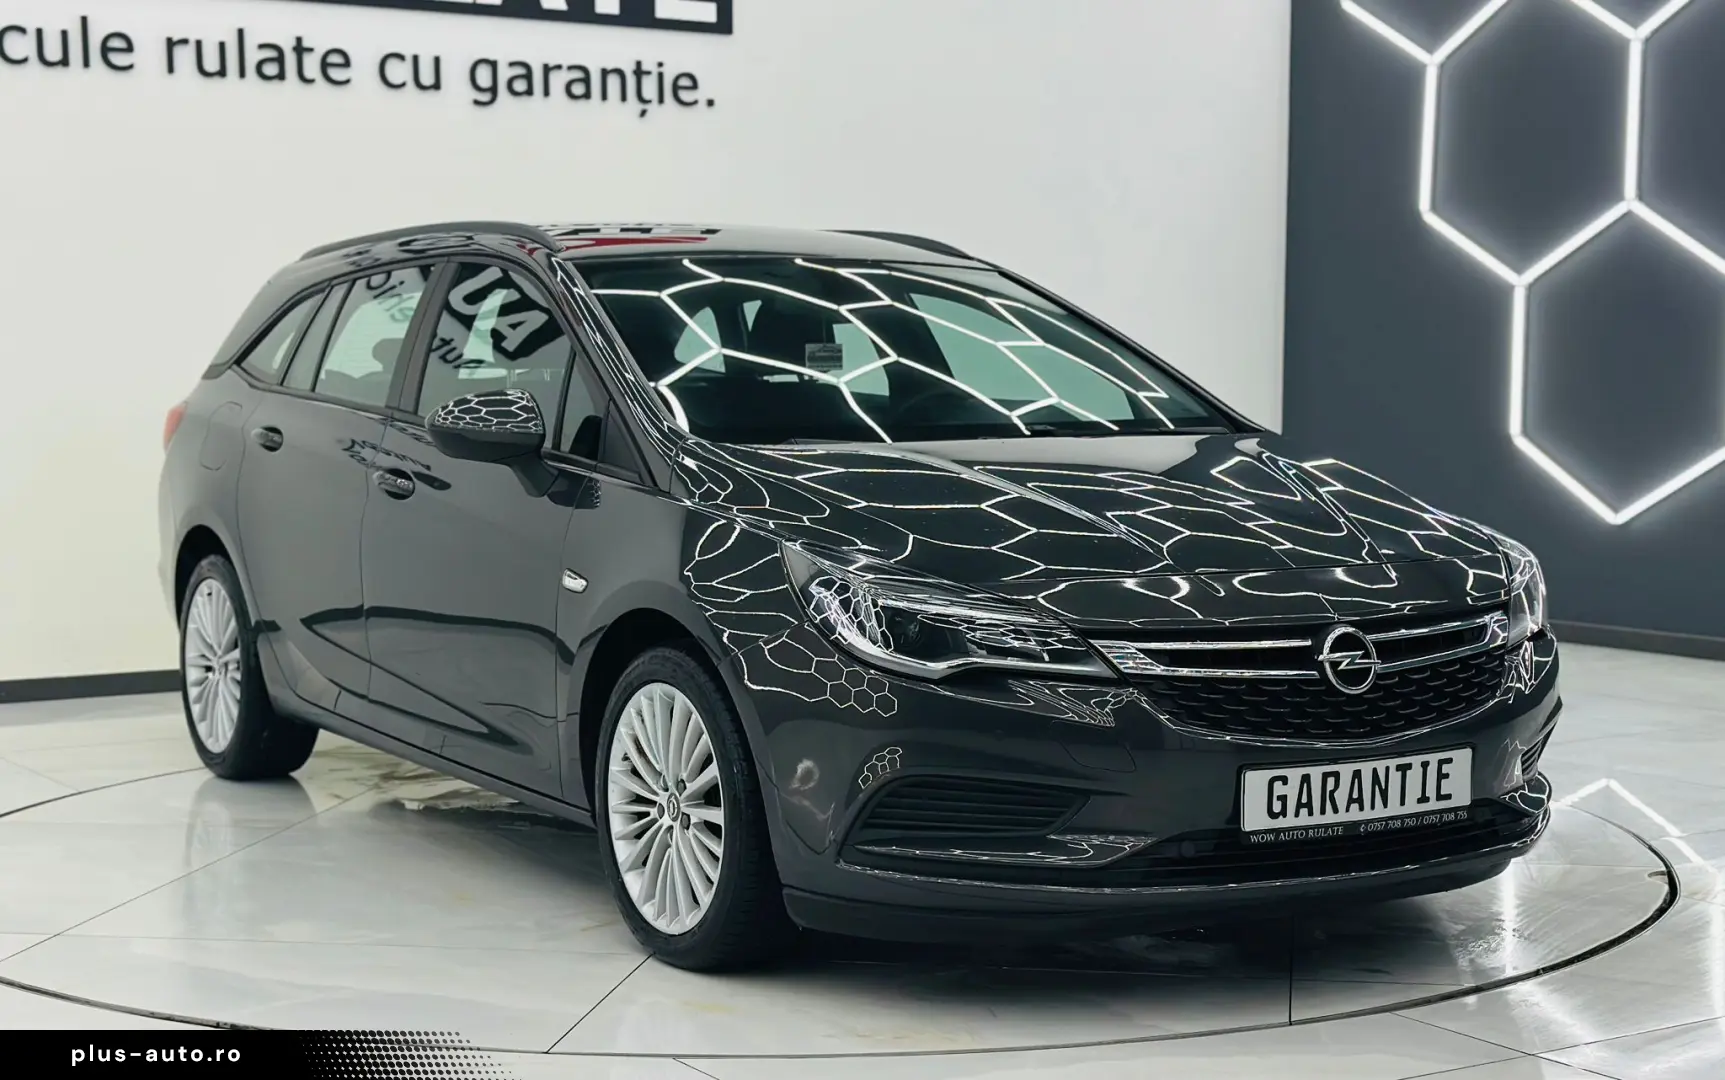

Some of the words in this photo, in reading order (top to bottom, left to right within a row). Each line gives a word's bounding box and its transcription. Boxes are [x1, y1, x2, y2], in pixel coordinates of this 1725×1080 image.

[0, 15, 135, 72] cule
[165, 27, 352, 87] rulate
[378, 52, 442, 92] cu
[469, 60, 716, 118] garanție.
[1266, 757, 1454, 820] GARANTIE
[1250, 832, 1276, 843] WOW
[1278, 829, 1306, 841] AUTO
[1308, 826, 1344, 838] RULATE
[1367, 821, 1386, 832] 0757
[1387, 819, 1401, 829] 708
[1403, 817, 1417, 828] 750
[1423, 814, 1440, 825] 0757
[1441, 812, 1455, 823] 708
